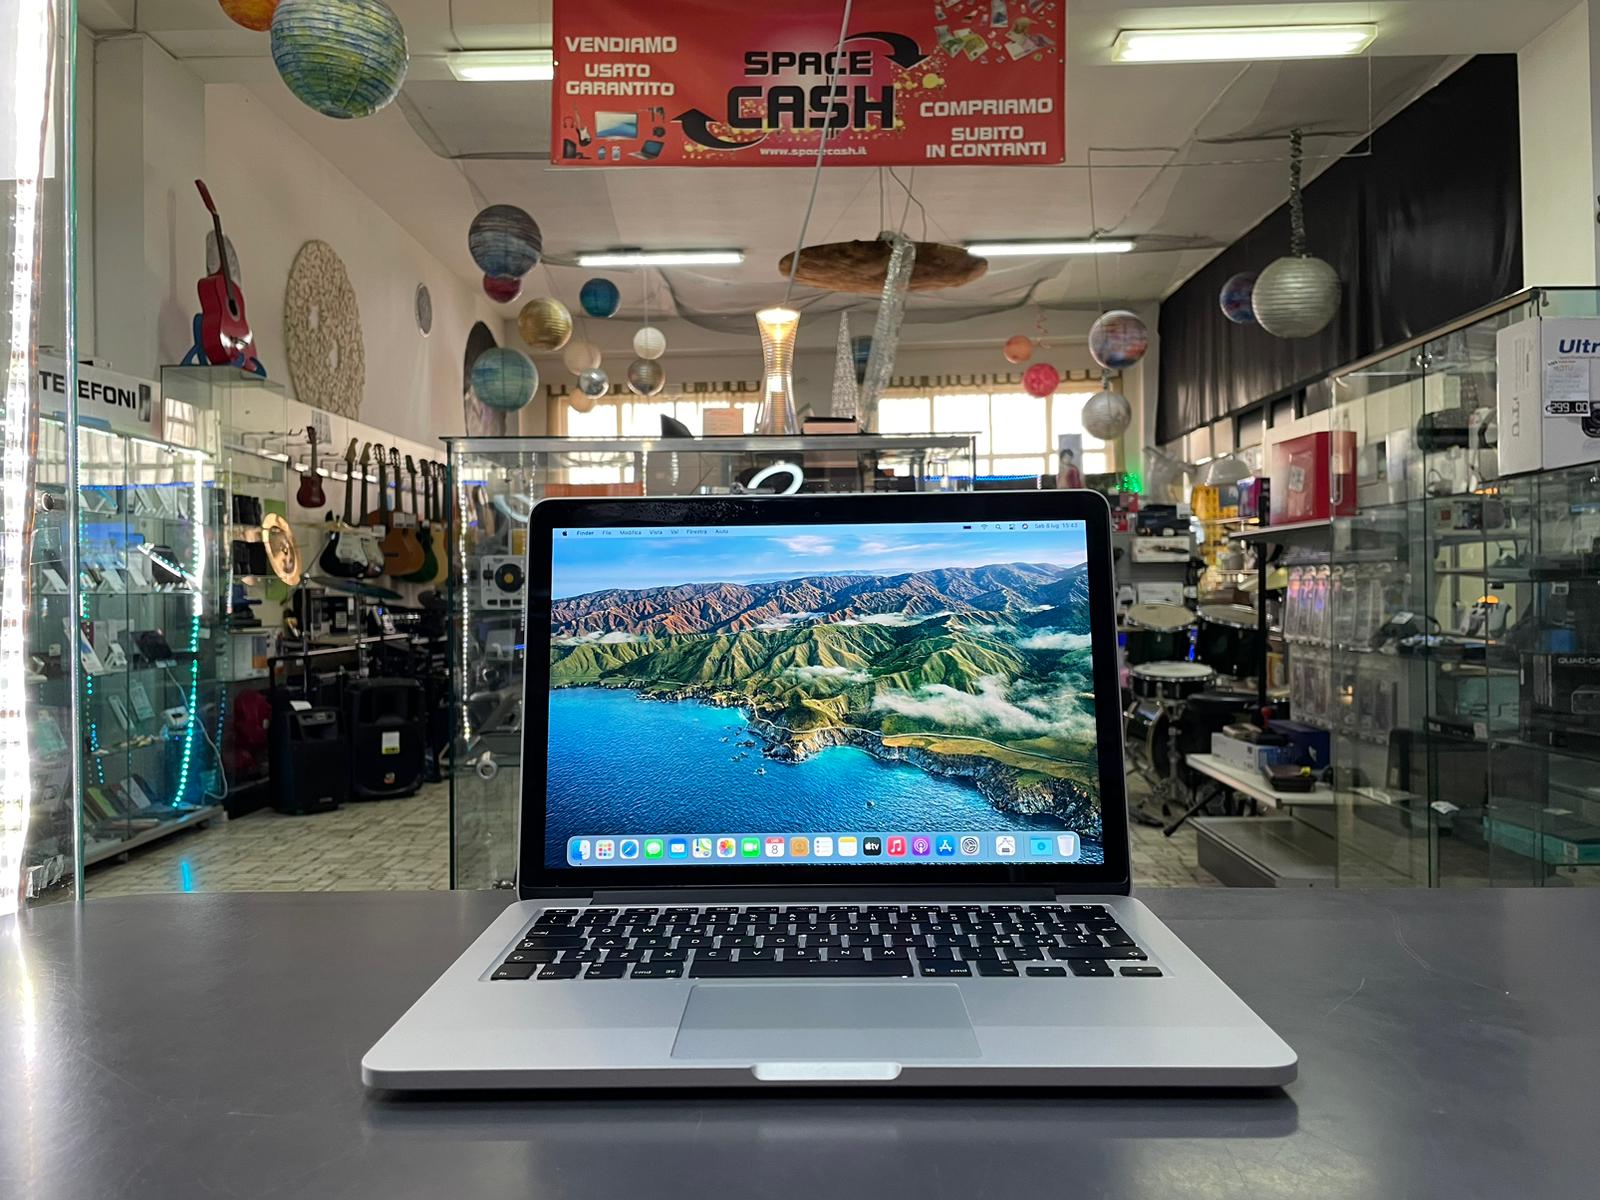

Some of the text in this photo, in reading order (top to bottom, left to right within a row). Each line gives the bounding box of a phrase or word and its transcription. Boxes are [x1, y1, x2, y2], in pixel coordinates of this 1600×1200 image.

[564, 36, 678, 53] VENDIAMO
[584, 63, 650, 78] USATO
[744, 51, 873, 76] SPACE
[565, 81, 675, 96] GARANTITO
[727, 85, 895, 129] CASH
[919, 97, 1054, 118] COMPRIAMO
[951, 126, 1024, 141] SUBITO
[760, 146, 868, 157] www.spaccash.it
[926, 142, 1047, 158] IN CONTANTI
[39, 370, 137, 410] TEEFONI
[771, 845, 779, 854] 8
